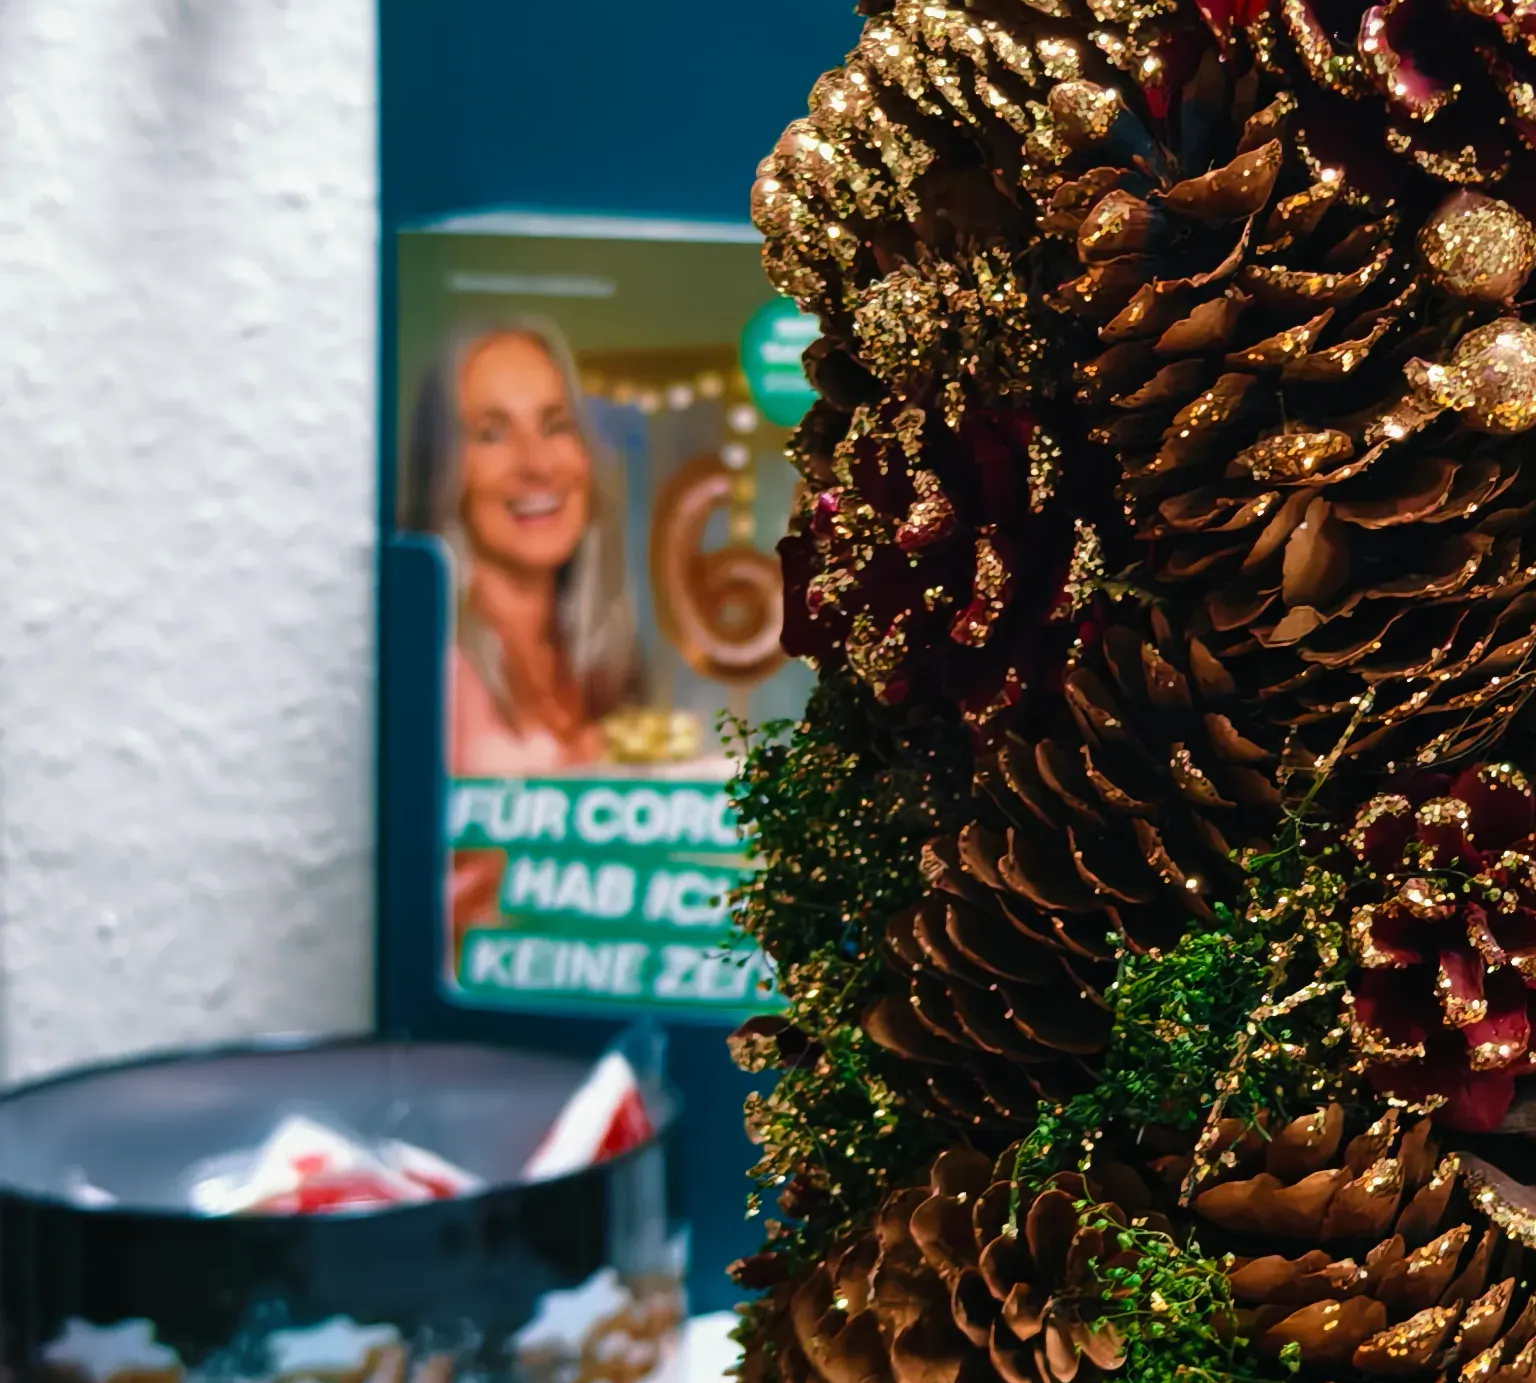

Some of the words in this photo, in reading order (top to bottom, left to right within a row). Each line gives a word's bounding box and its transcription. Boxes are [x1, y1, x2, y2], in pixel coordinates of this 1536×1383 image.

[448, 781, 569, 842] FÜR
[576, 788, 748, 845] CORO
[507, 857, 636, 917] HAB
[470, 936, 649, 994] KEINE
